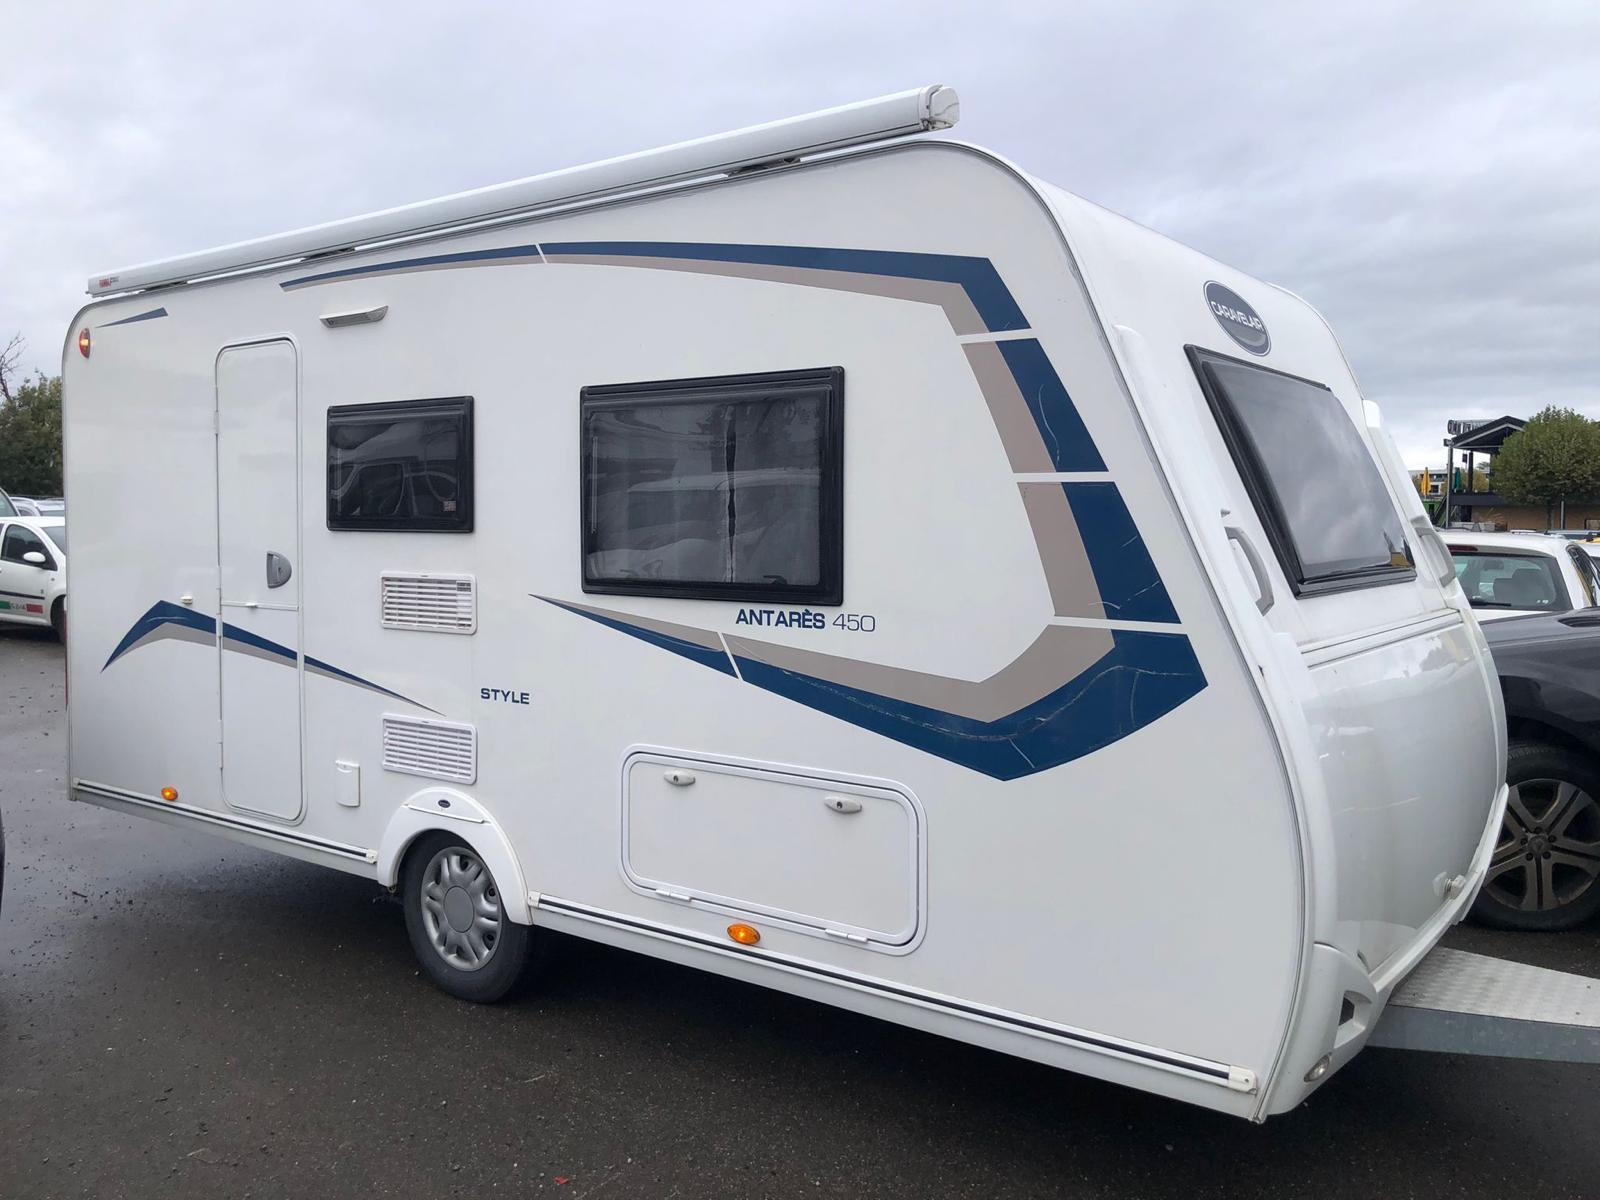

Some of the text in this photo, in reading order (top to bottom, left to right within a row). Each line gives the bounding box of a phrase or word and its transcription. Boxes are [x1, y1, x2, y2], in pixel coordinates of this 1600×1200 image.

[735, 608, 876, 633] ANTARÈS 450
[480, 687, 530, 705] STYLE
